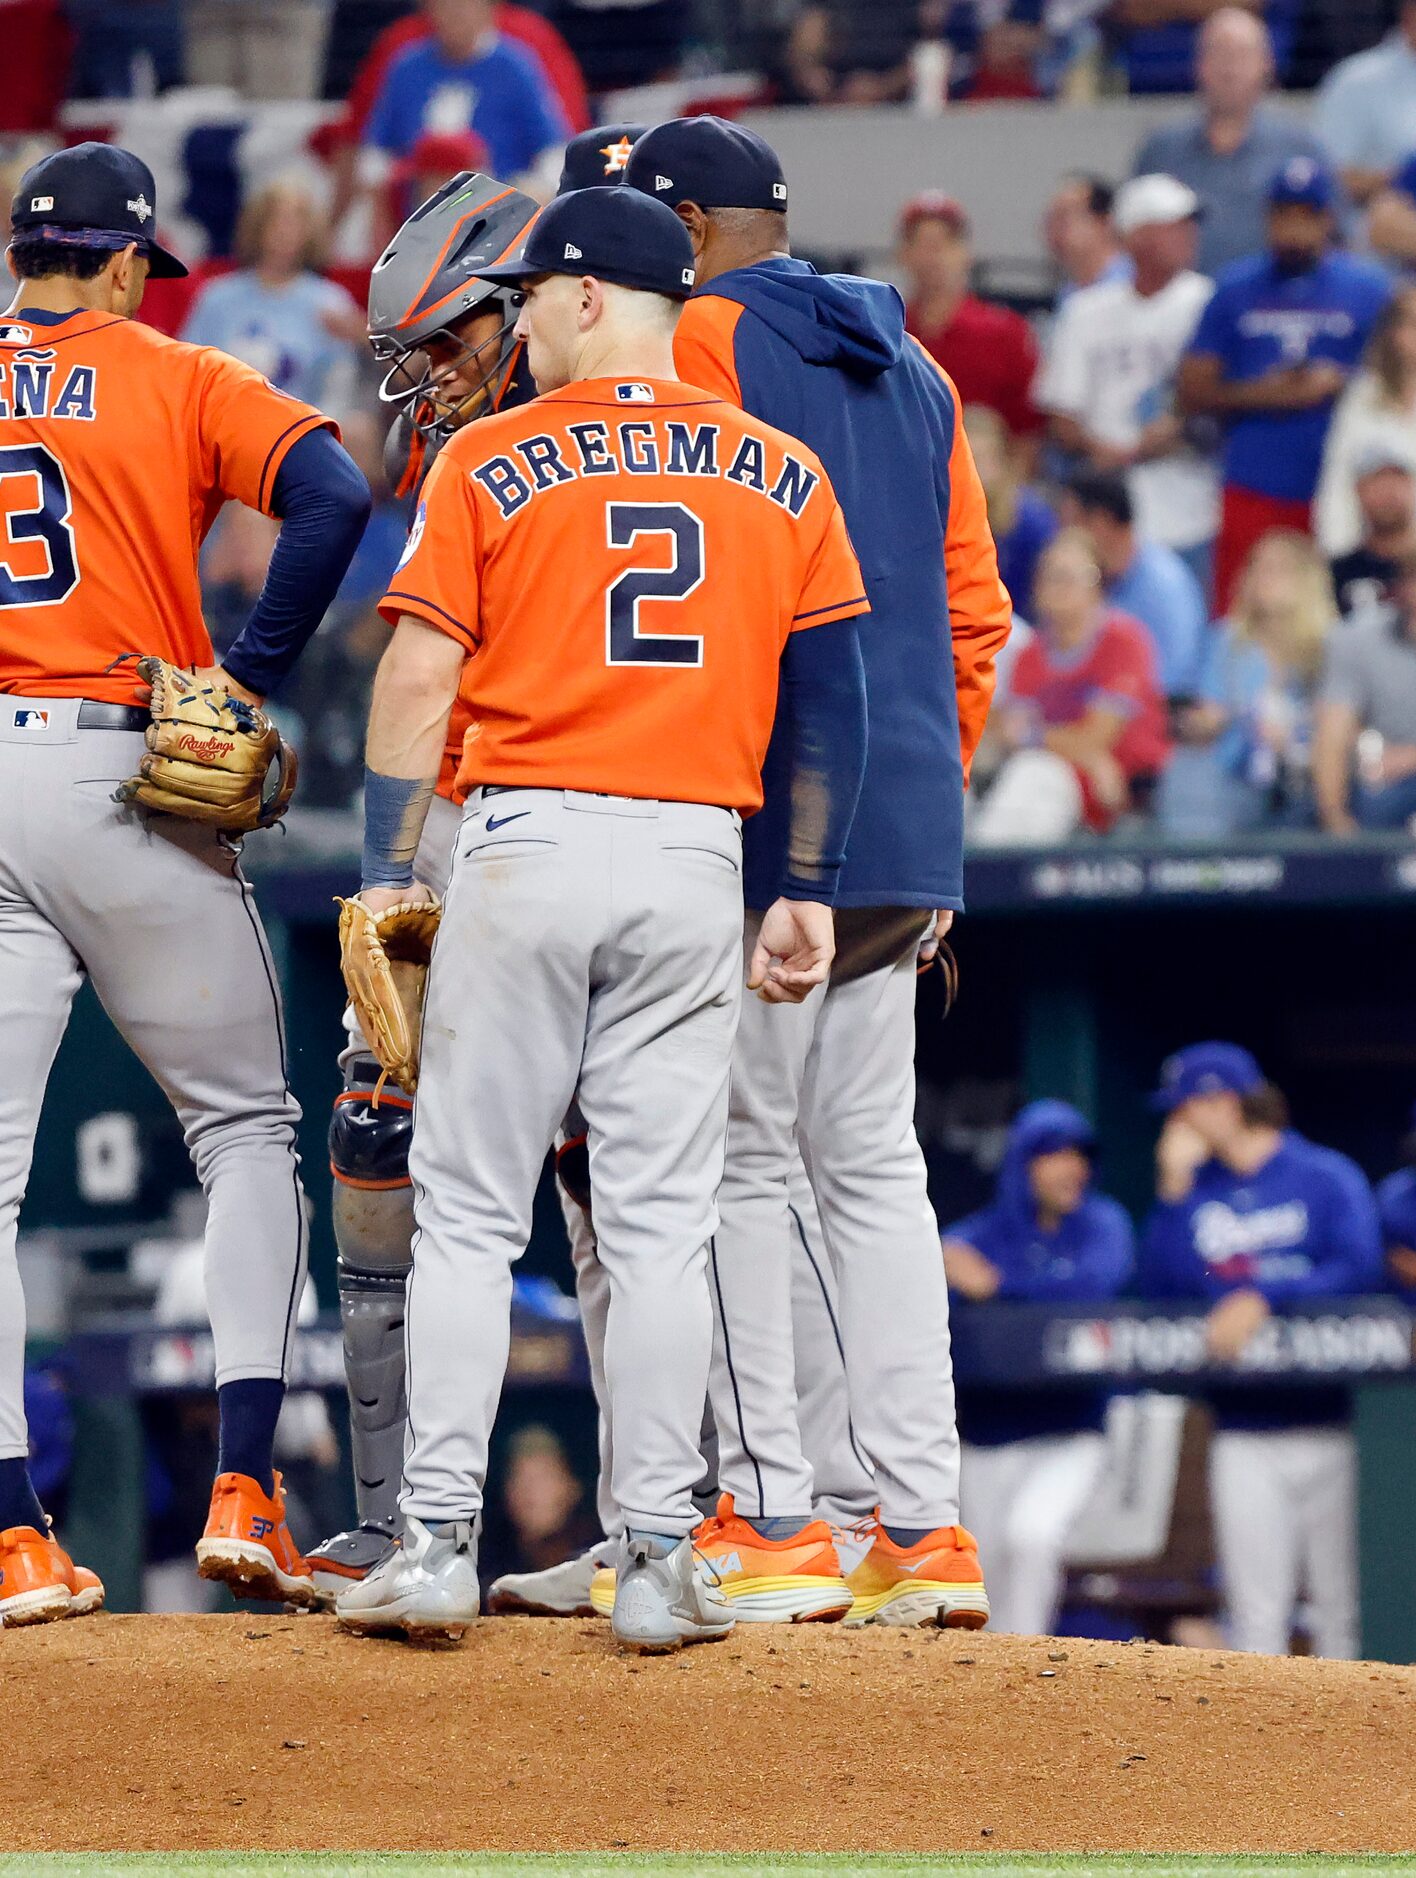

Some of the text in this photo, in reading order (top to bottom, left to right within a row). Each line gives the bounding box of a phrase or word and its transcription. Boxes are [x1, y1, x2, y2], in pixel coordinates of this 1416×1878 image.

[0, 349, 97, 421] ÑA
[471, 420, 820, 521] BREGMAN
[0, 442, 82, 611] 3
[605, 501, 705, 667] 2
[178, 733, 236, 758] Rawlings
